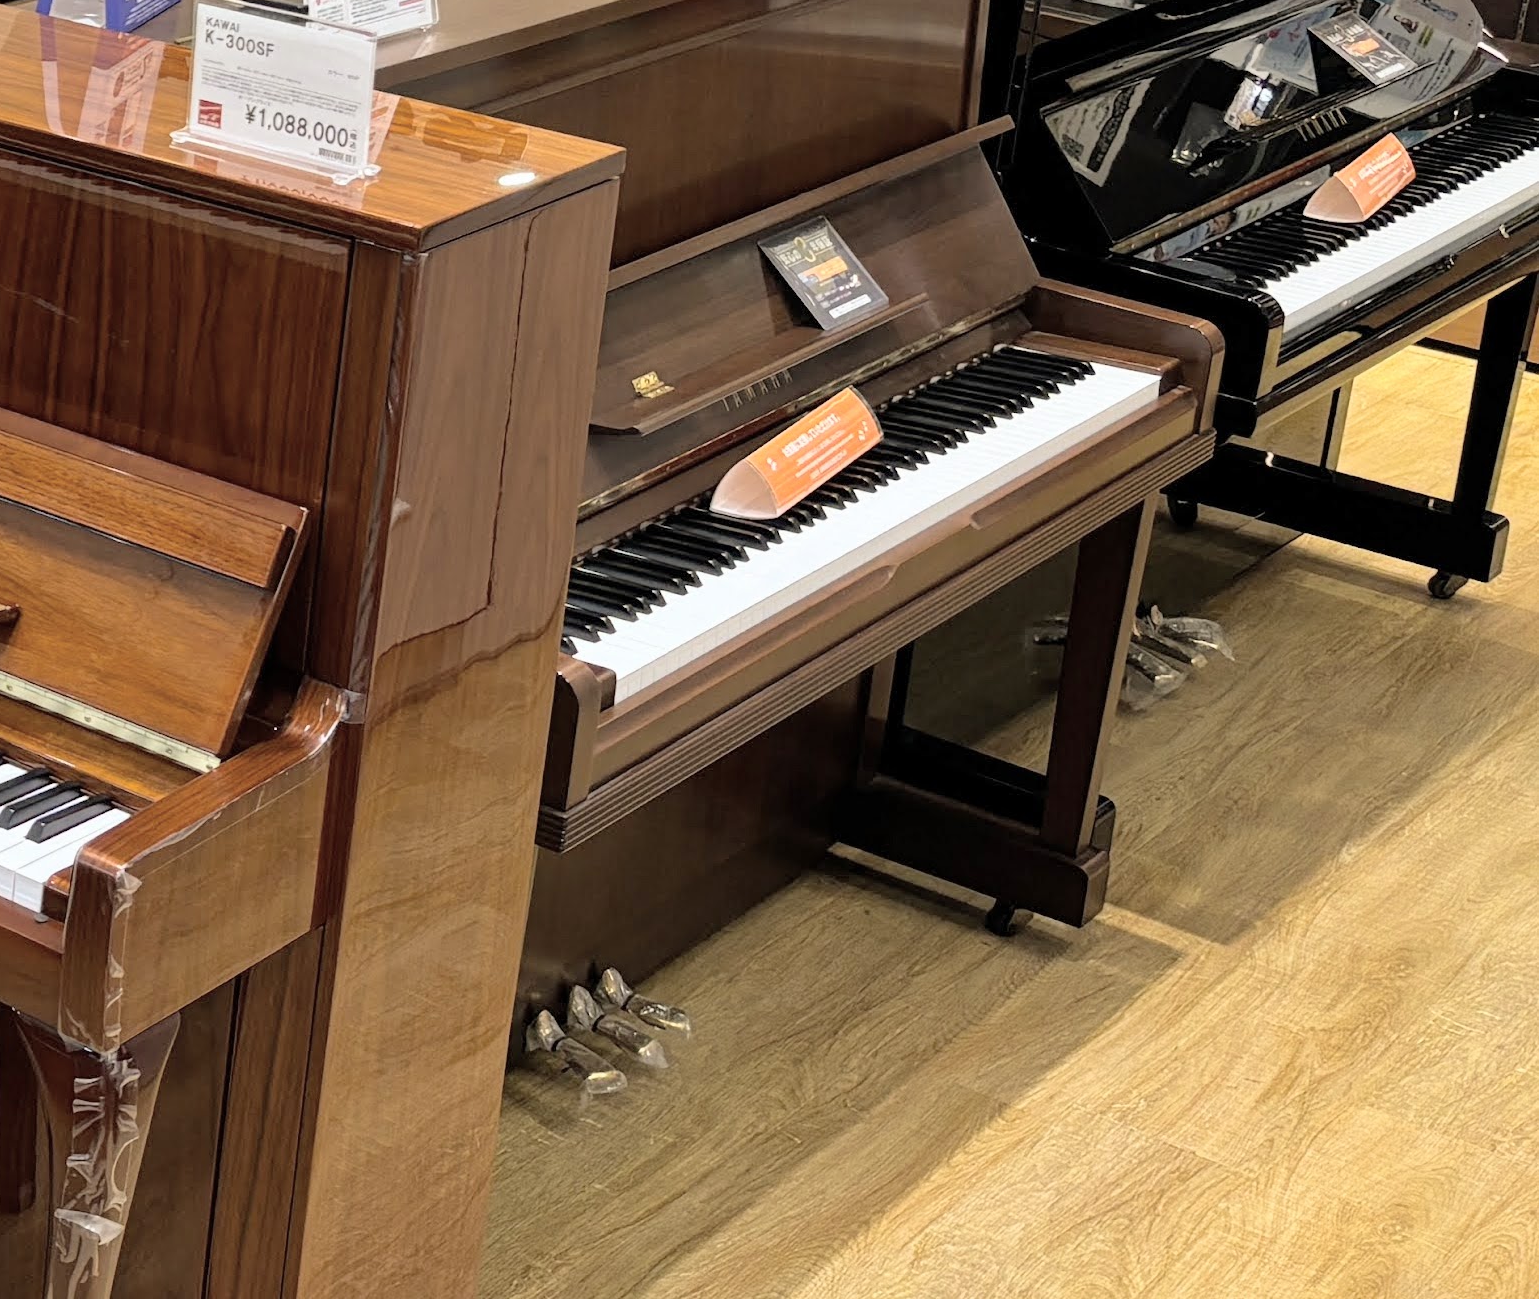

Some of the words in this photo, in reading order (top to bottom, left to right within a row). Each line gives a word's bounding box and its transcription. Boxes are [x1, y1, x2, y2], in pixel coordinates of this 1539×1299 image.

[206, 17, 240, 33] KAWAI
[205, 29, 275, 57] K-300SF
[245, 104, 348, 147] ¥1,088,000
